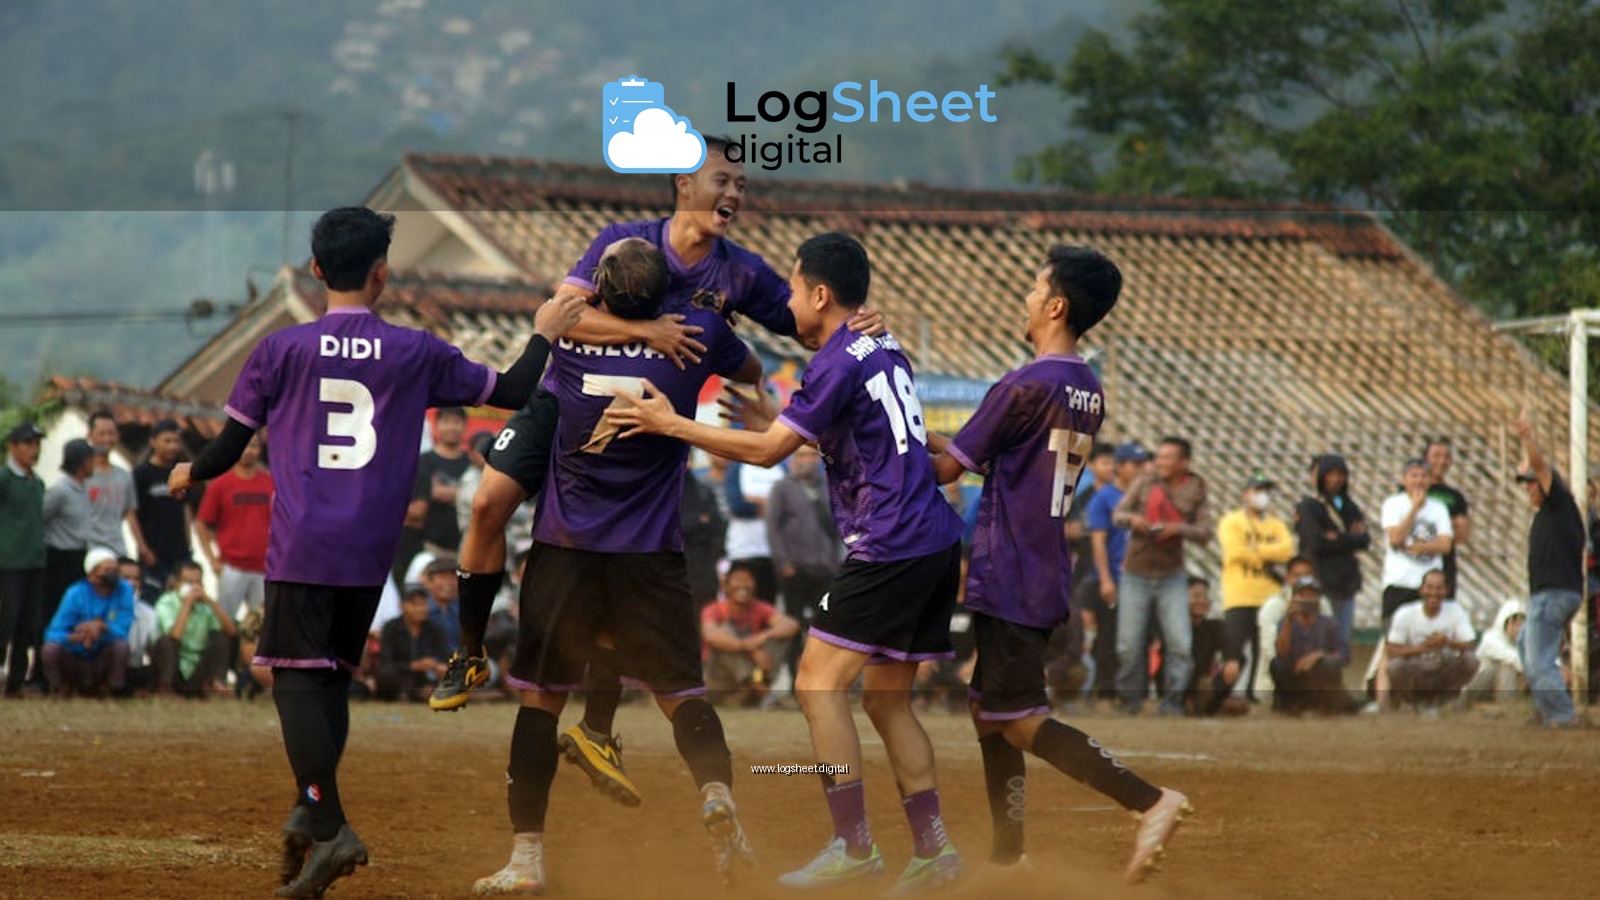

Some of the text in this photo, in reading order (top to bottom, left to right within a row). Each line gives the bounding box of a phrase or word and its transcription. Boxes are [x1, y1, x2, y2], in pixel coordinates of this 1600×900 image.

[320, 334, 381, 361] DIDI
[318, 377, 378, 470] 3
[581, 373, 646, 454] 7
[864, 365, 928, 456] 18
[1064, 385, 1102, 415] TATA
[493, 428, 516, 451] 8
